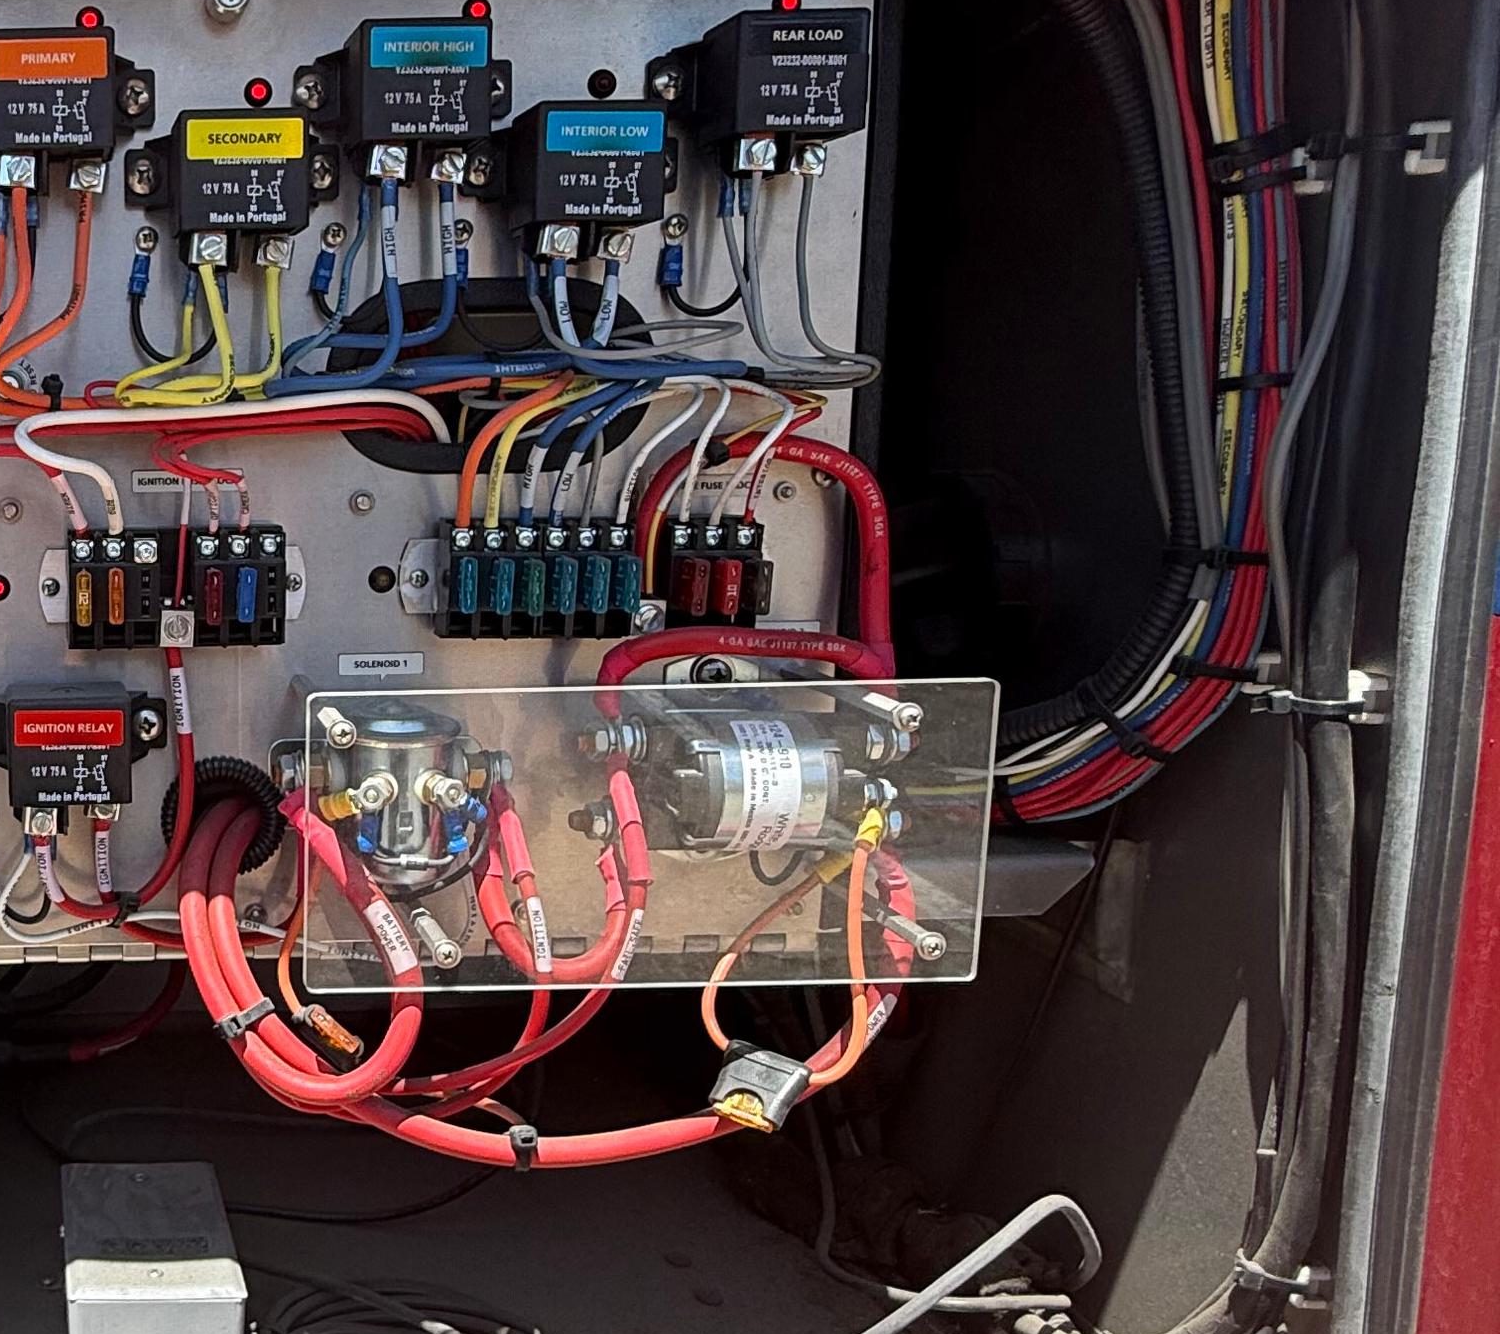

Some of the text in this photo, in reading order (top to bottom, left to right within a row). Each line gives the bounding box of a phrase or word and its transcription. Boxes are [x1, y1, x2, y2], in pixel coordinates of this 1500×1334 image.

[772, 30, 844, 41] REAR LOAD
[384, 41, 474, 52] INTERIOR HIGH
[21, 53, 76, 64] PRIMARY
[766, 114, 844, 127] Made in Portugal
[391, 121, 469, 134] Made in Portugal
[561, 126, 649, 137] INTERIOR LOW
[15, 132, 93, 145] Made in Portugal
[207, 133, 282, 145] SECONDARY
[565, 204, 642, 217] Made in Portugal
[209, 212, 287, 224] Made in Portugal
[385, 227, 396, 256] HIGH
[442, 224, 453, 255] HIGH
[601, 298, 613, 321] LOW
[137, 477, 179, 486] IGNITION
[523, 463, 534, 489] HIGH
[789, 447, 804, 458] GA
[863, 482, 882, 510] TYPE
[700, 481, 723, 490] FUSE
[801, 640, 824, 650] TYPE
[353, 659, 408, 669] SOLENOID 1
[172, 674, 184, 727] IGNITION
[23, 723, 114, 734] IGNITION RELAY
[38, 791, 111, 802] Made in Portugal
[98, 836, 110, 885] IGNITION
[376, 924, 397, 953] POWER
[381, 912, 411, 952] BATTERY
[531, 909, 547, 960] IGNITION
